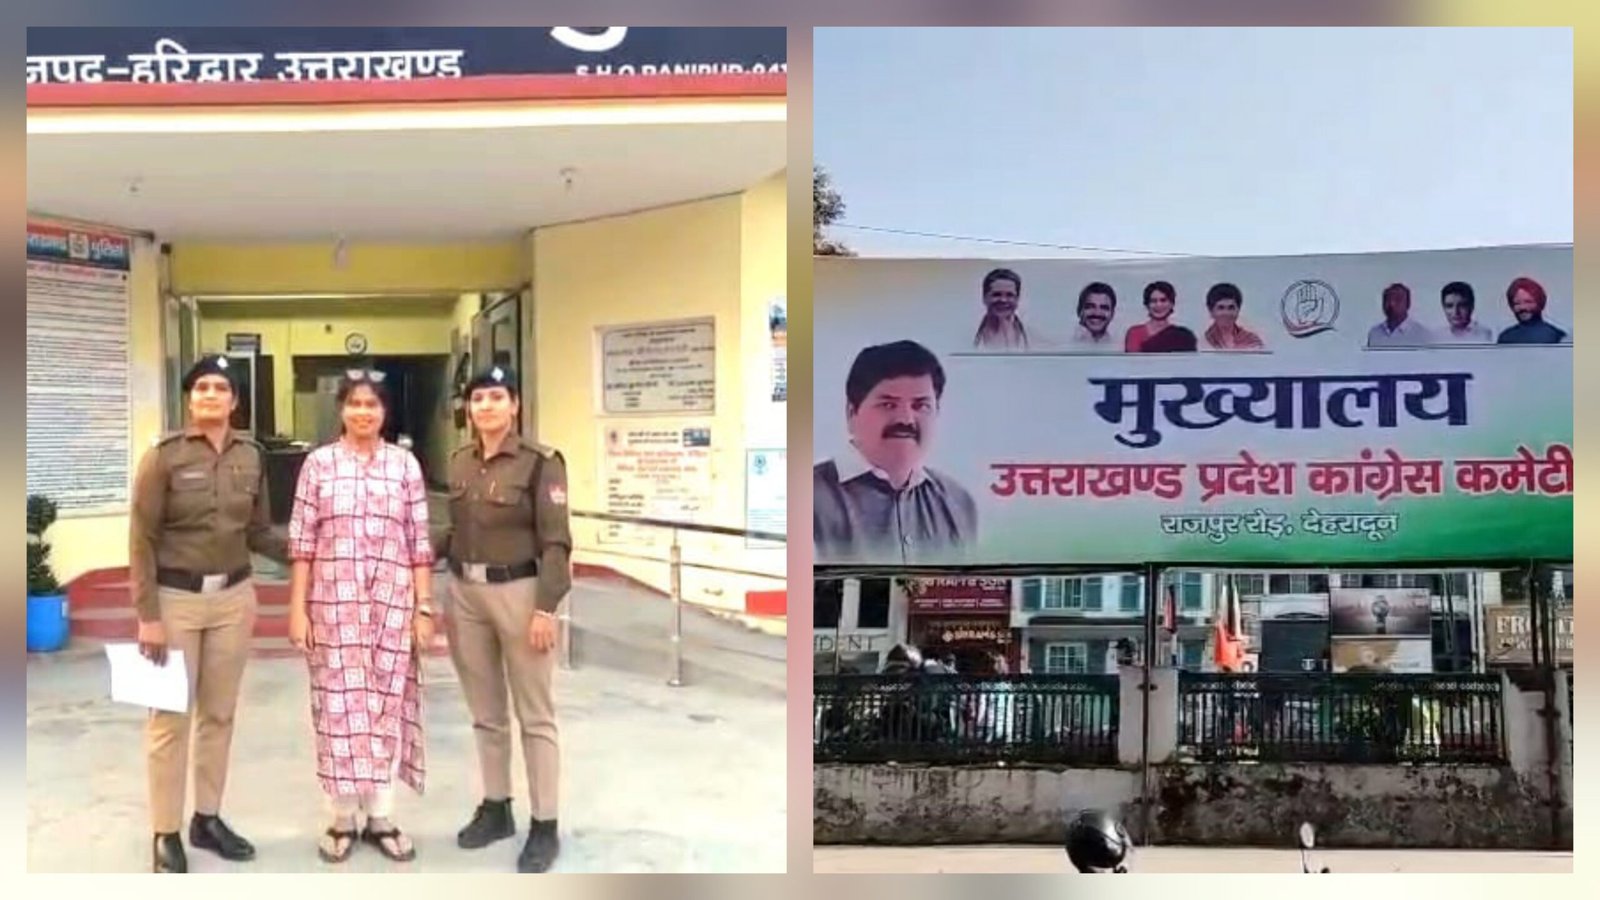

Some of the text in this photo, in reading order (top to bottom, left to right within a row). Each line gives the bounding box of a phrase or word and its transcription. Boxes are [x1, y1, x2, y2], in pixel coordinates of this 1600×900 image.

[1088, 373, 1472, 448] मुख्यालय
[989, 444, 1574, 502] उत्तराखण्ड प्रदेश कांग्रेस कमेटी
[1160, 514, 1242, 544] राजपुर
[1300, 508, 1399, 541] देहरादून
